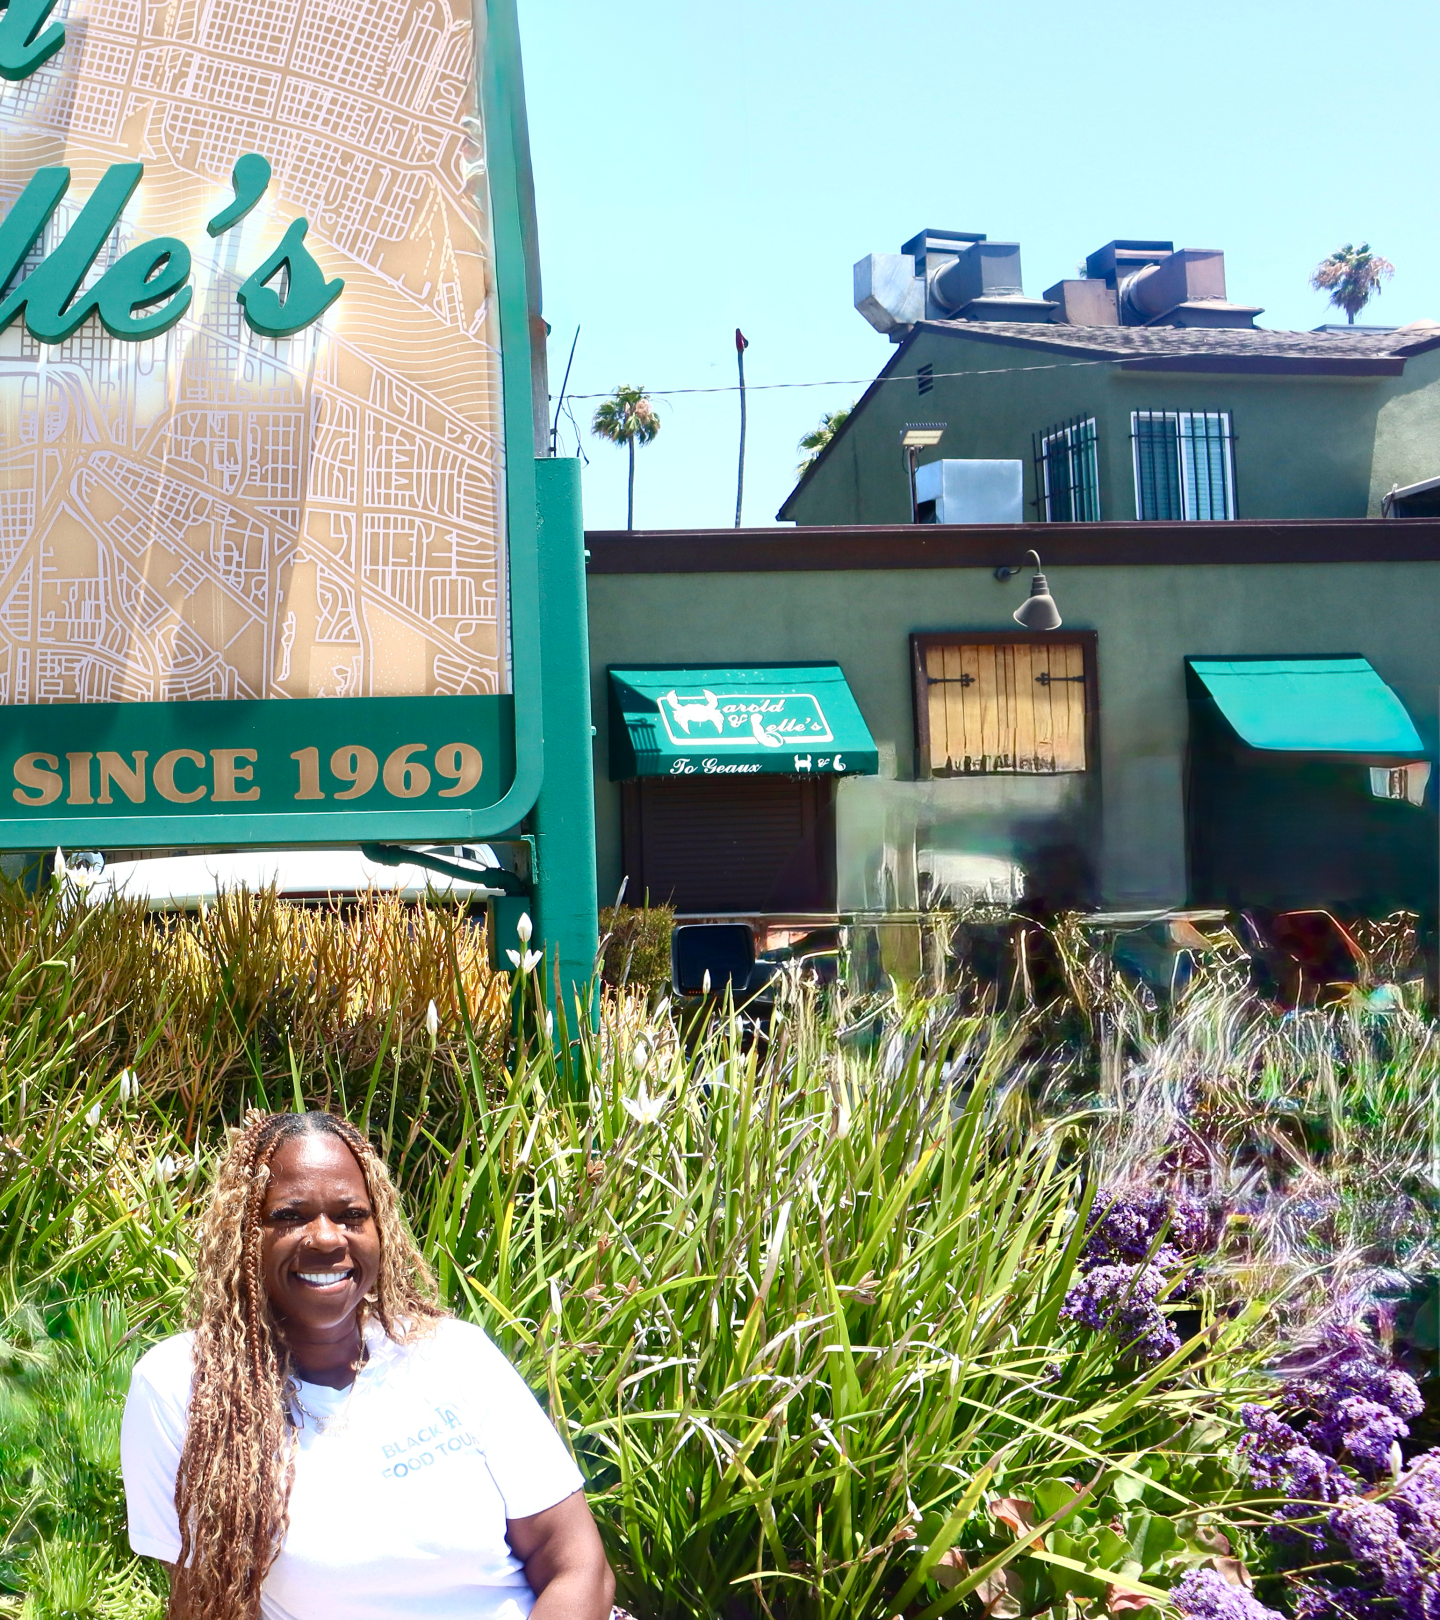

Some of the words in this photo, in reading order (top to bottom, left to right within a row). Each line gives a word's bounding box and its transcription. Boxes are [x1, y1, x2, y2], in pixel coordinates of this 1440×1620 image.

[12, 747, 261, 807] SINCE
[290, 742, 484, 800] 1969
[669, 758, 698, 775] To
[701, 757, 763, 774] Geaux
[381, 1423, 444, 1459] BLACK
